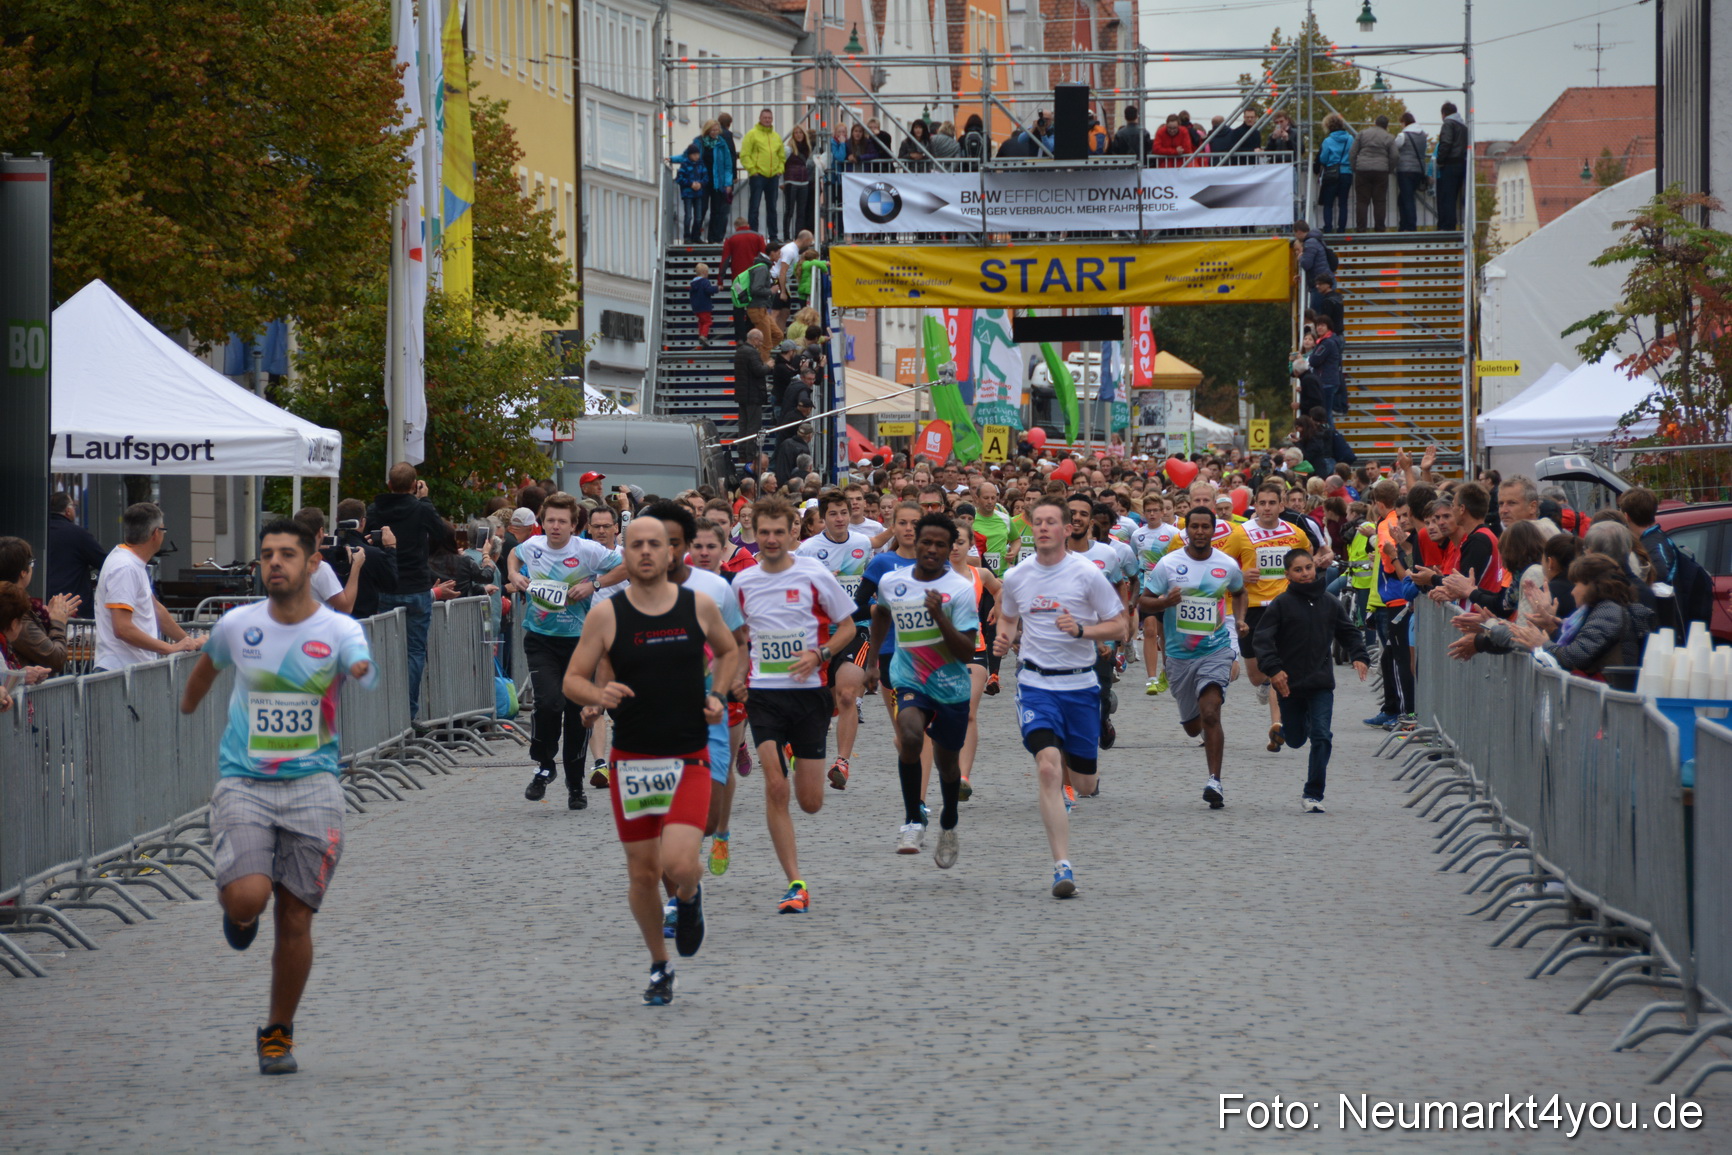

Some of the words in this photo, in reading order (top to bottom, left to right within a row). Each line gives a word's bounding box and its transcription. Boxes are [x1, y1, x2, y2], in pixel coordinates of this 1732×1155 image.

[961, 190, 1002, 204] BMW
[961, 206, 1007, 216] WENGER
[1009, 205, 1075, 215] VERBRAUCH.
[1077, 204, 1106, 214] MEHR
[980, 256, 1136, 293] START
[1164, 273, 1218, 282] Neumarkter
[1220, 271, 1263, 281] Stadtlauf
[855, 277, 909, 287] Neumarkter
[910, 277, 953, 287] Stadtlauf
[1477, 365, 1513, 373] Toiletten
[986, 426, 1006, 434] Block
[1254, 428, 1265, 443] C
[65, 434, 215, 466] Laufsport
[988, 436, 1002, 454] A
[1260, 554, 1282, 567] 516
[1180, 604, 1212, 621] 5331
[896, 611, 934, 630] 5329
[645, 628, 687, 638] CHOOZA
[761, 640, 803, 660] 5309
[250, 698, 273, 706] PARTL
[275, 698, 308, 706] Neumarkt
[257, 708, 313, 733] 5333
[626, 772, 676, 795] 5180
